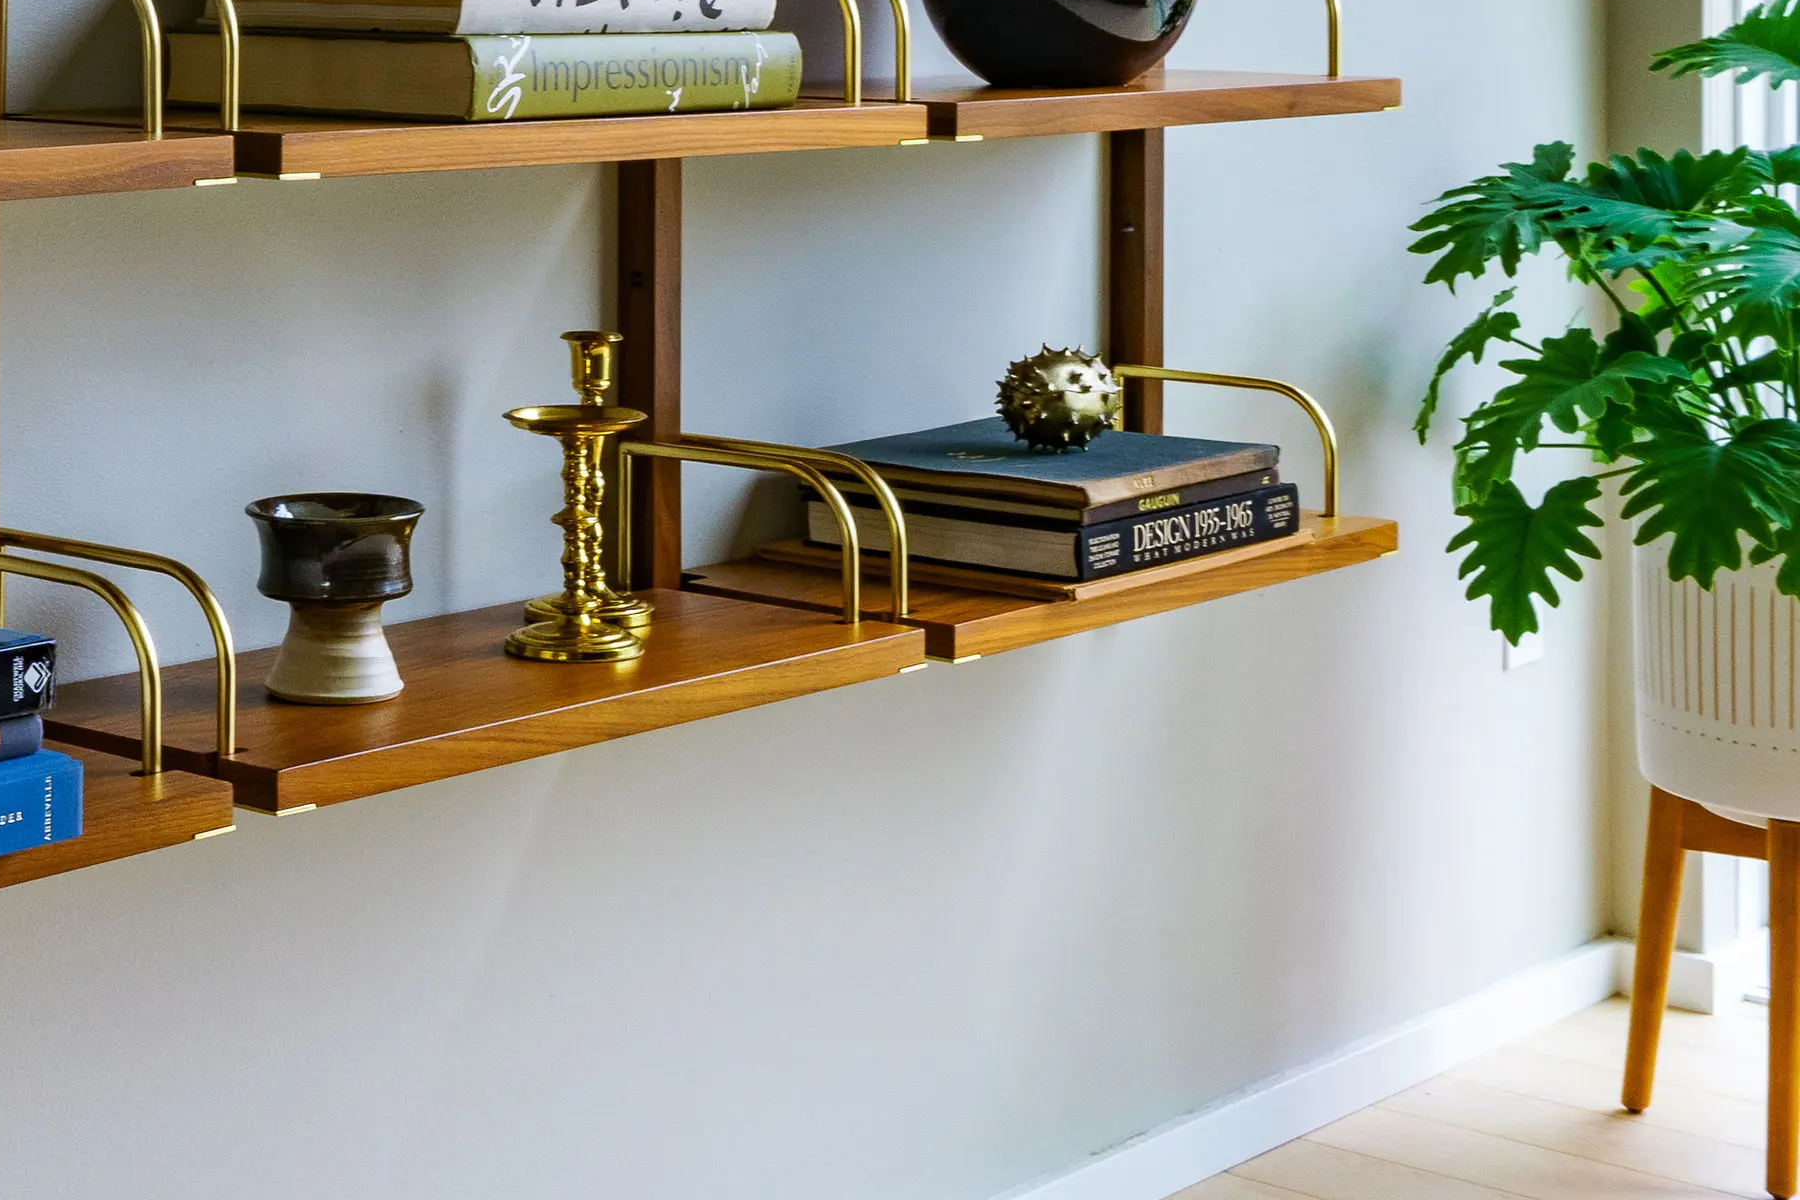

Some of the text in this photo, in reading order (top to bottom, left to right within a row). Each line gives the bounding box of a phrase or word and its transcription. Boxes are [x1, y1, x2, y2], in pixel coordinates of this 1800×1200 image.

[531, 48, 750, 102] Impressionism
[1138, 492, 1180, 512] GAUGUIN
[1132, 500, 1253, 552] DESIGN 1935-1965
[1132, 547, 1168, 563] WHAT
[1173, 534, 1226, 555] MODERN
[1231, 527, 1256, 541] WAS
